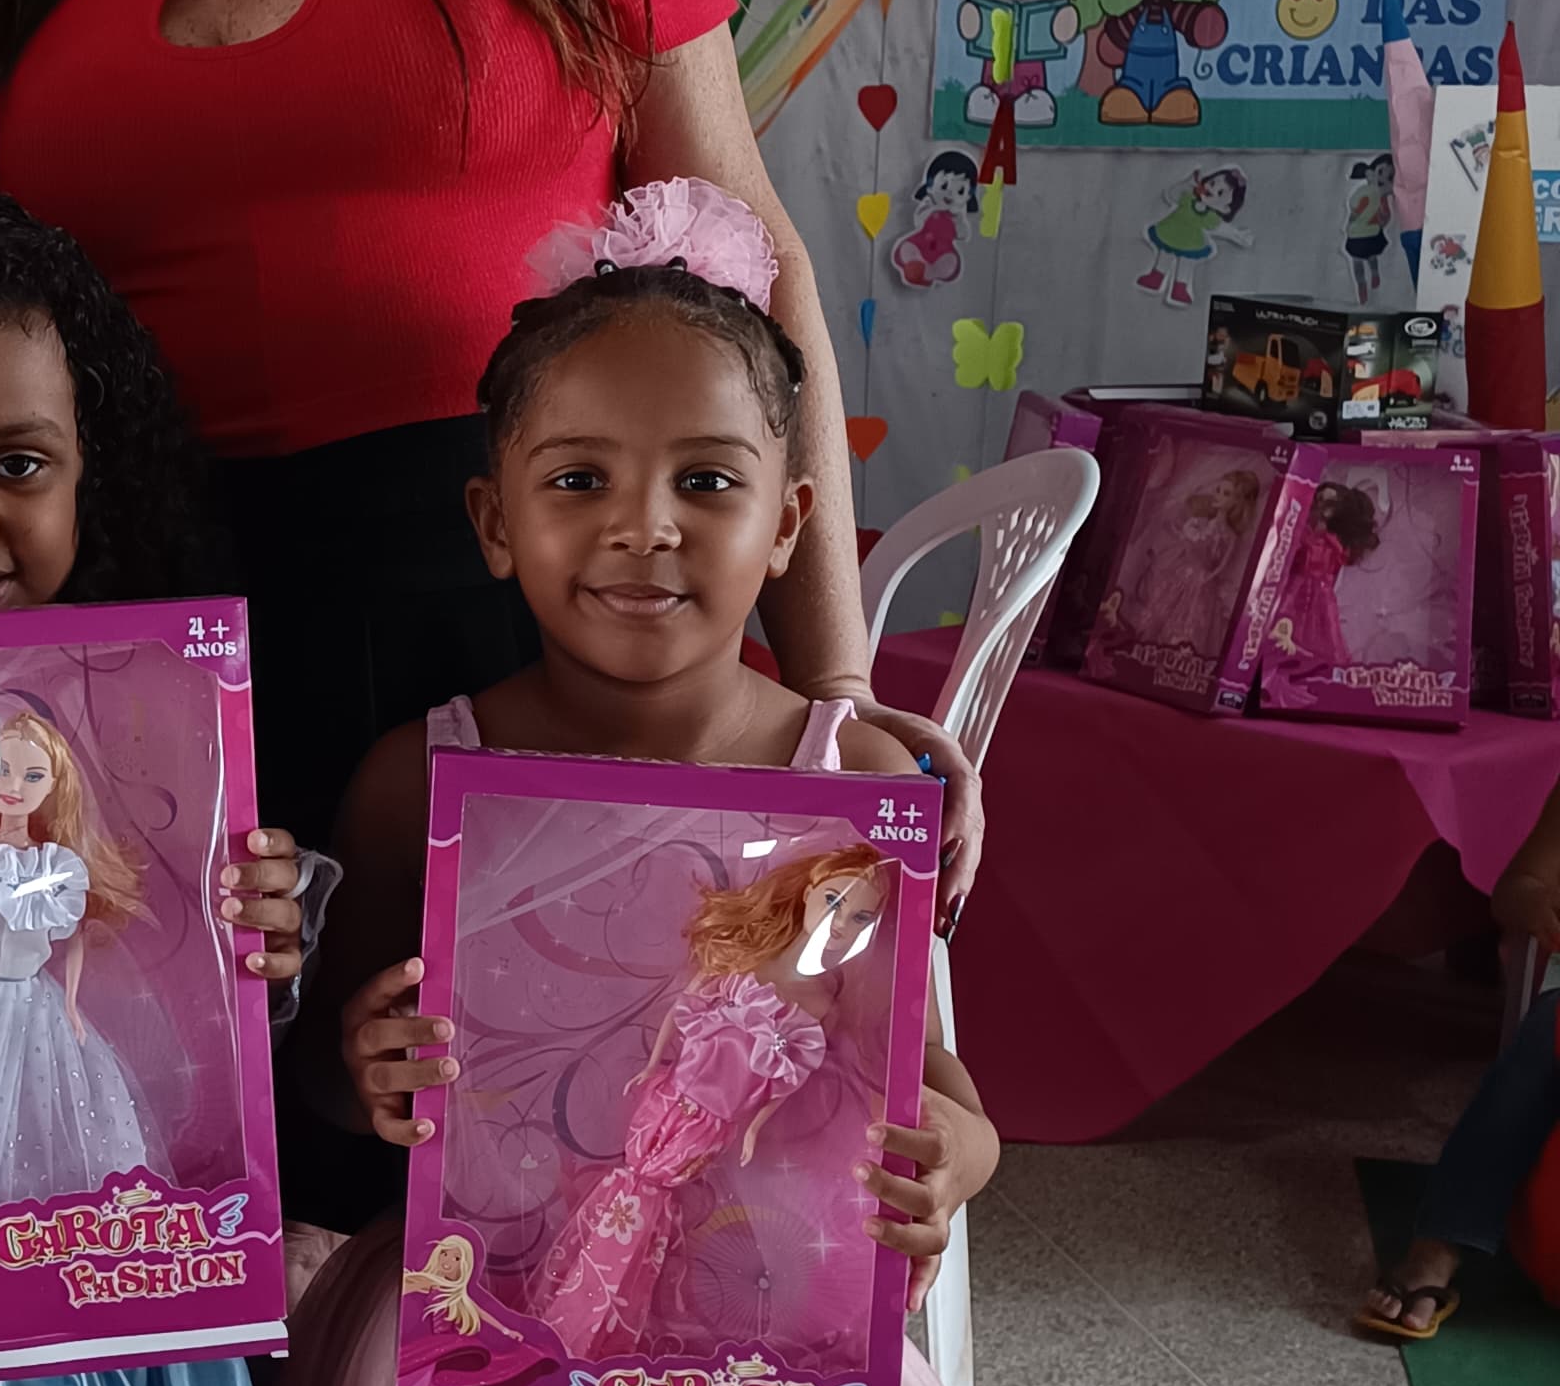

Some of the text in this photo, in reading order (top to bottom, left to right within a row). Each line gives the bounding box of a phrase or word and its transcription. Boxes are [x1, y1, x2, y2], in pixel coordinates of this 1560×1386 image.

[1217, 44, 1494, 86] CRIANAS
[188, 616, 230, 641] 4+
[183, 641, 237, 658] ANOS
[877, 798, 923, 825] 4+
[869, 825, 928, 843] ANOS
[60, 1250, 246, 1309] FASHION
